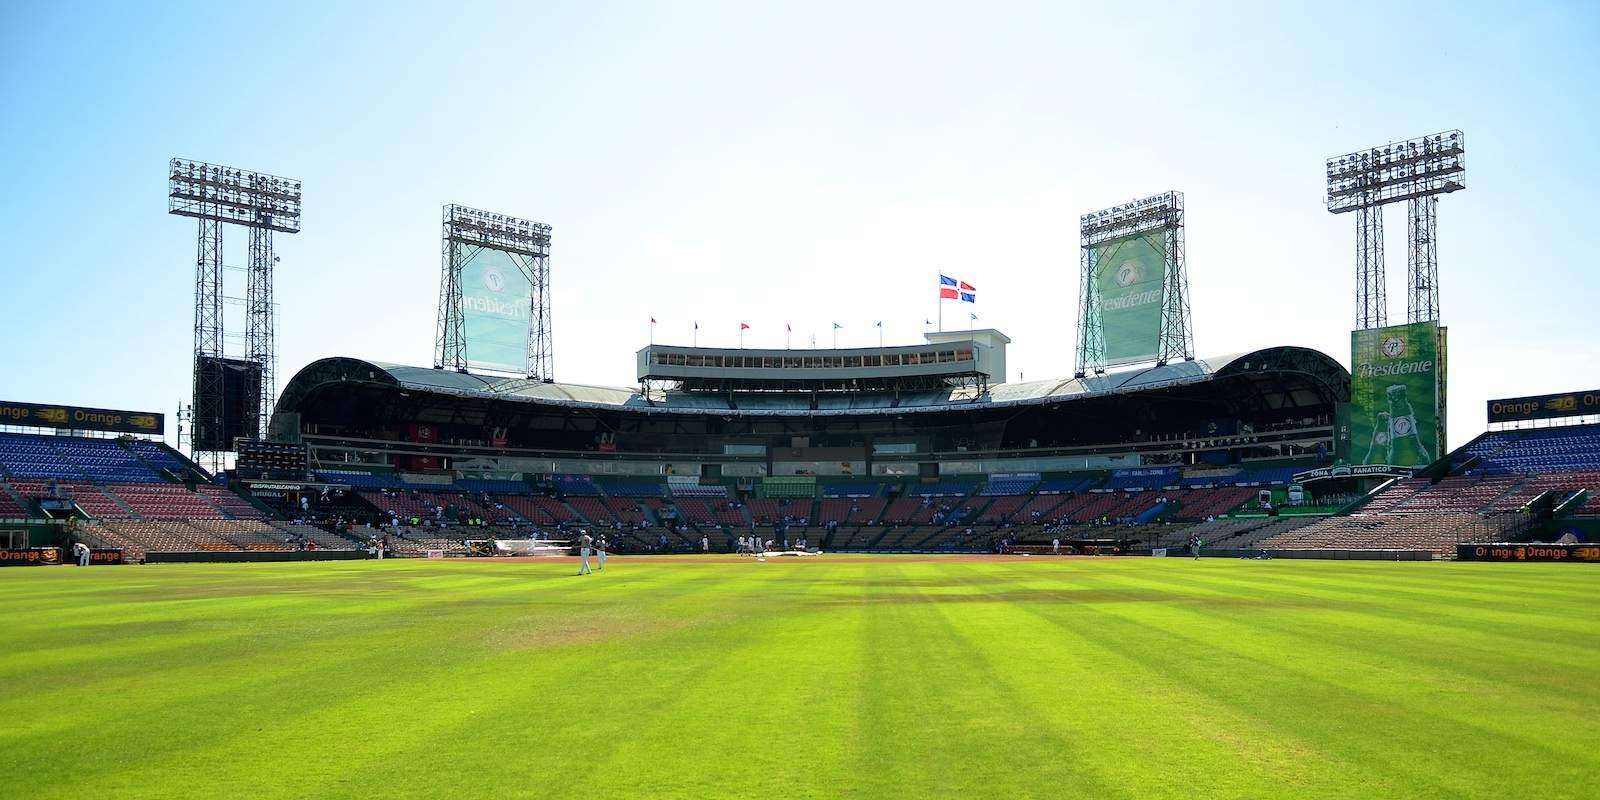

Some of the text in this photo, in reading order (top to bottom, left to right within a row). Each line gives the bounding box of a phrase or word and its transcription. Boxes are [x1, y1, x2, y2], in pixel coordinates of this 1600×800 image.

[1358, 360, 1433, 378] Presidente
[1492, 401, 1539, 414] Orange
[74, 410, 122, 425] Orange
[1353, 466, 1392, 474] FANATICOS
[0, 551, 40, 561] Orange
[90, 551, 120, 561] range
[1528, 547, 1568, 558] Orange
